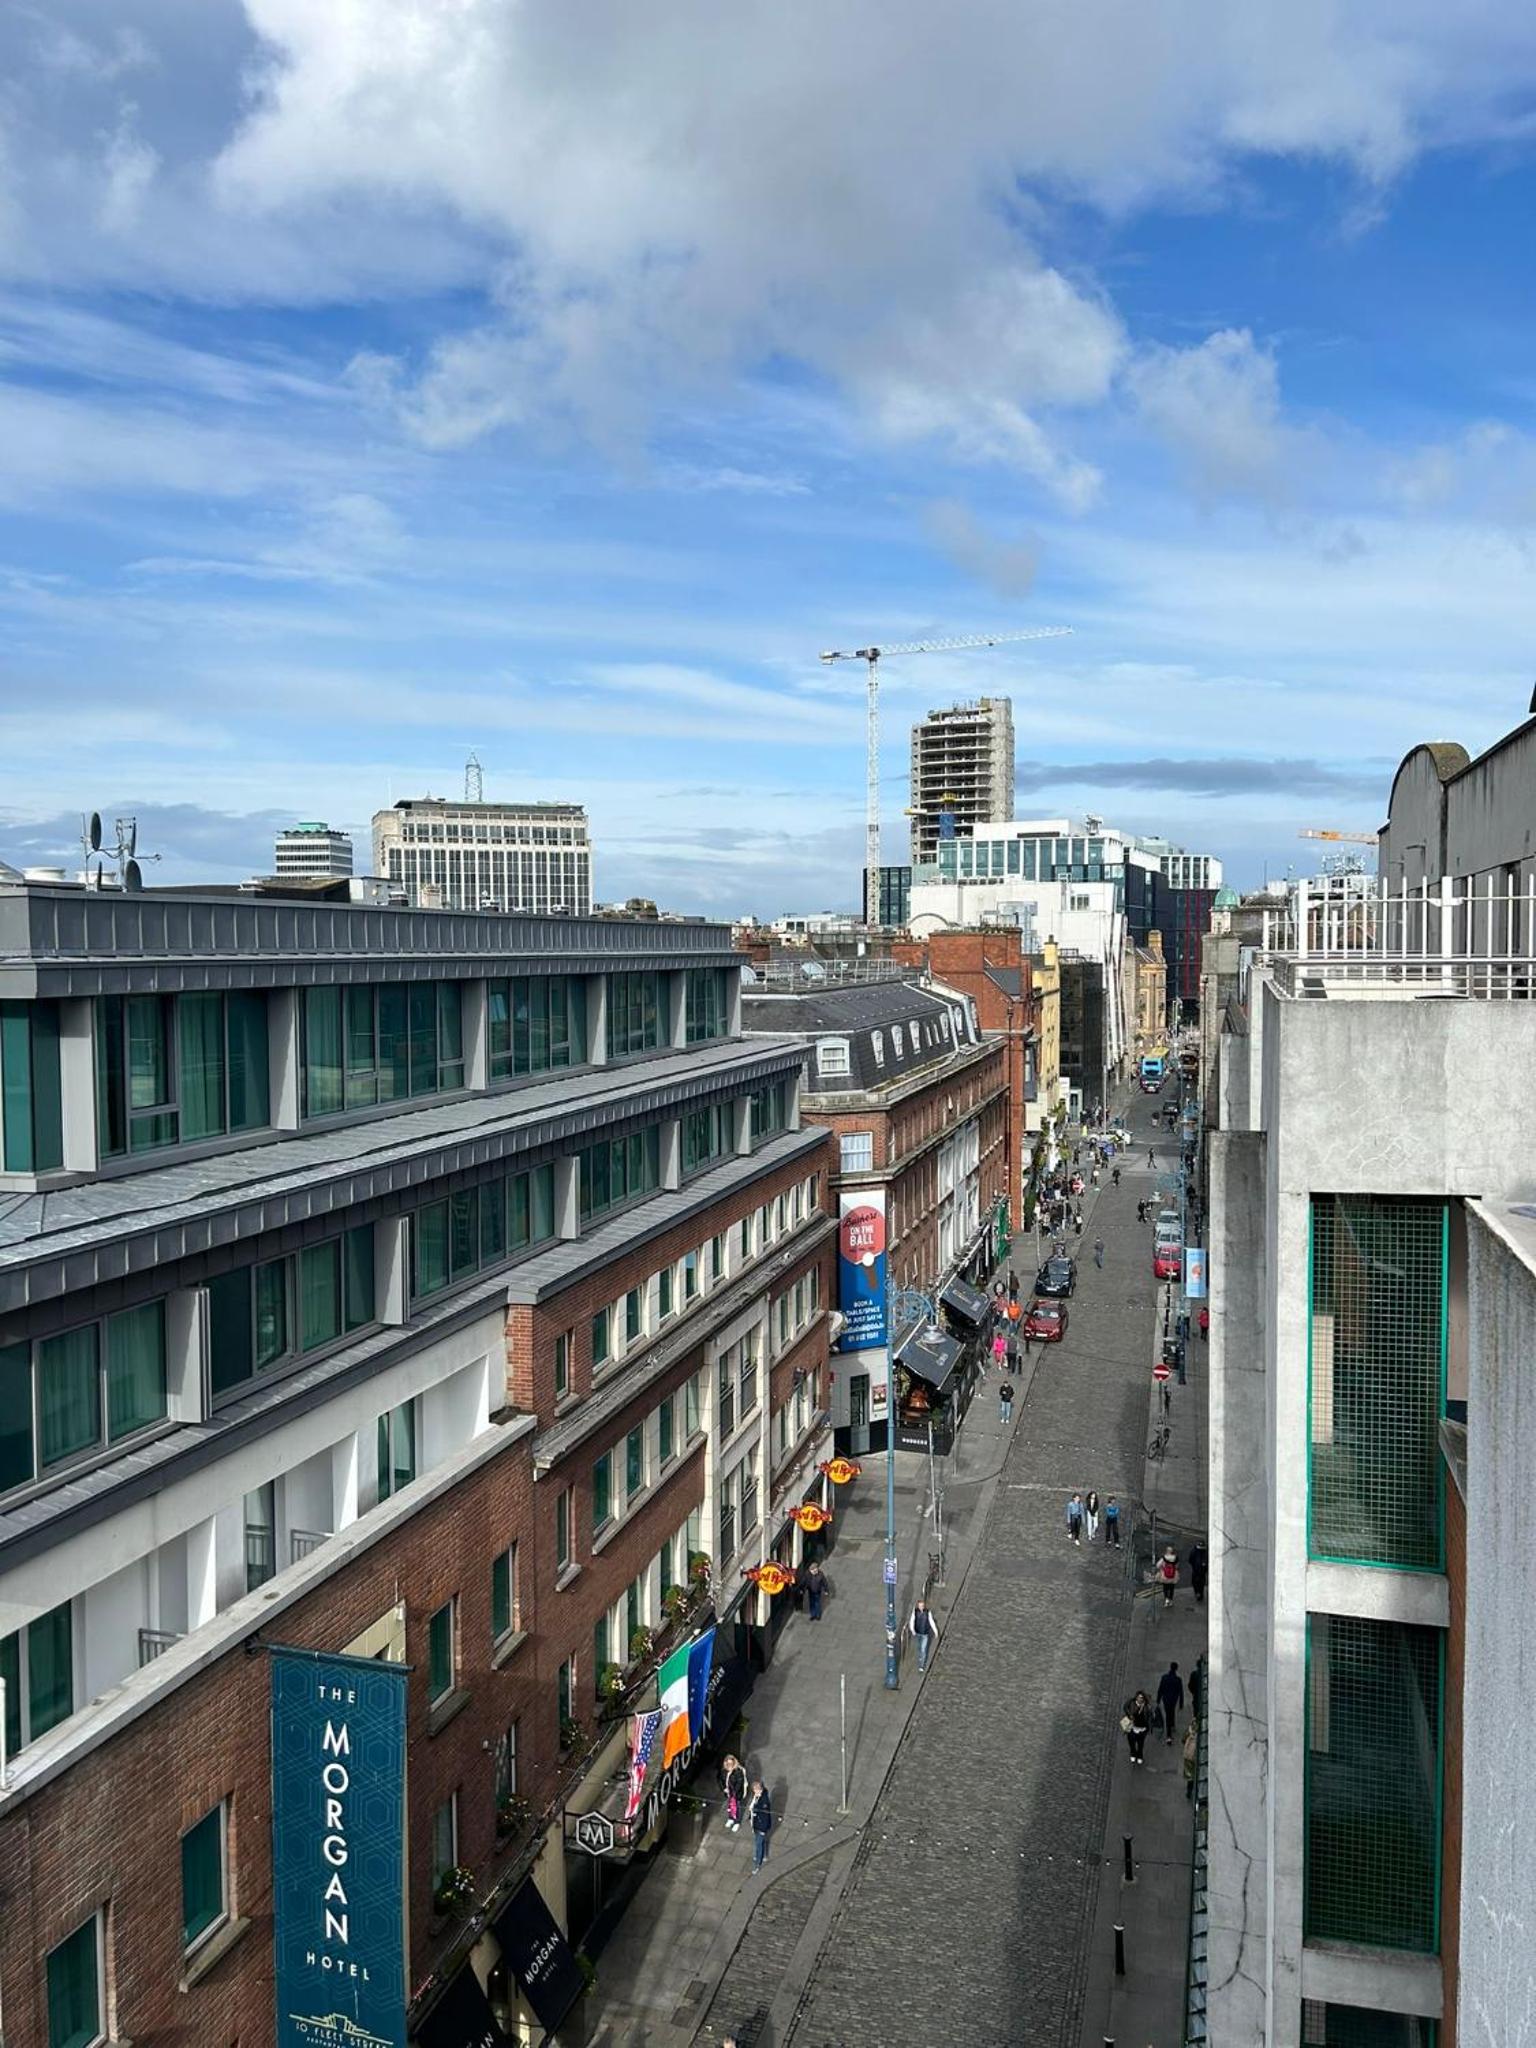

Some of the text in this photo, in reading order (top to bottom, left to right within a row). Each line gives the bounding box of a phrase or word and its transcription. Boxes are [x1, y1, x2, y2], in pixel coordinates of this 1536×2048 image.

[850, 1224, 875, 1235] ON THE
[850, 1233, 874, 1247] BALL
[318, 1686, 355, 1704] THE
[322, 1719, 350, 1945] MORGAN
[306, 1952, 370, 1981] HOTEL
[524, 1932, 561, 1985] MORGAN
[350, 2037, 388, 2048] STRE
